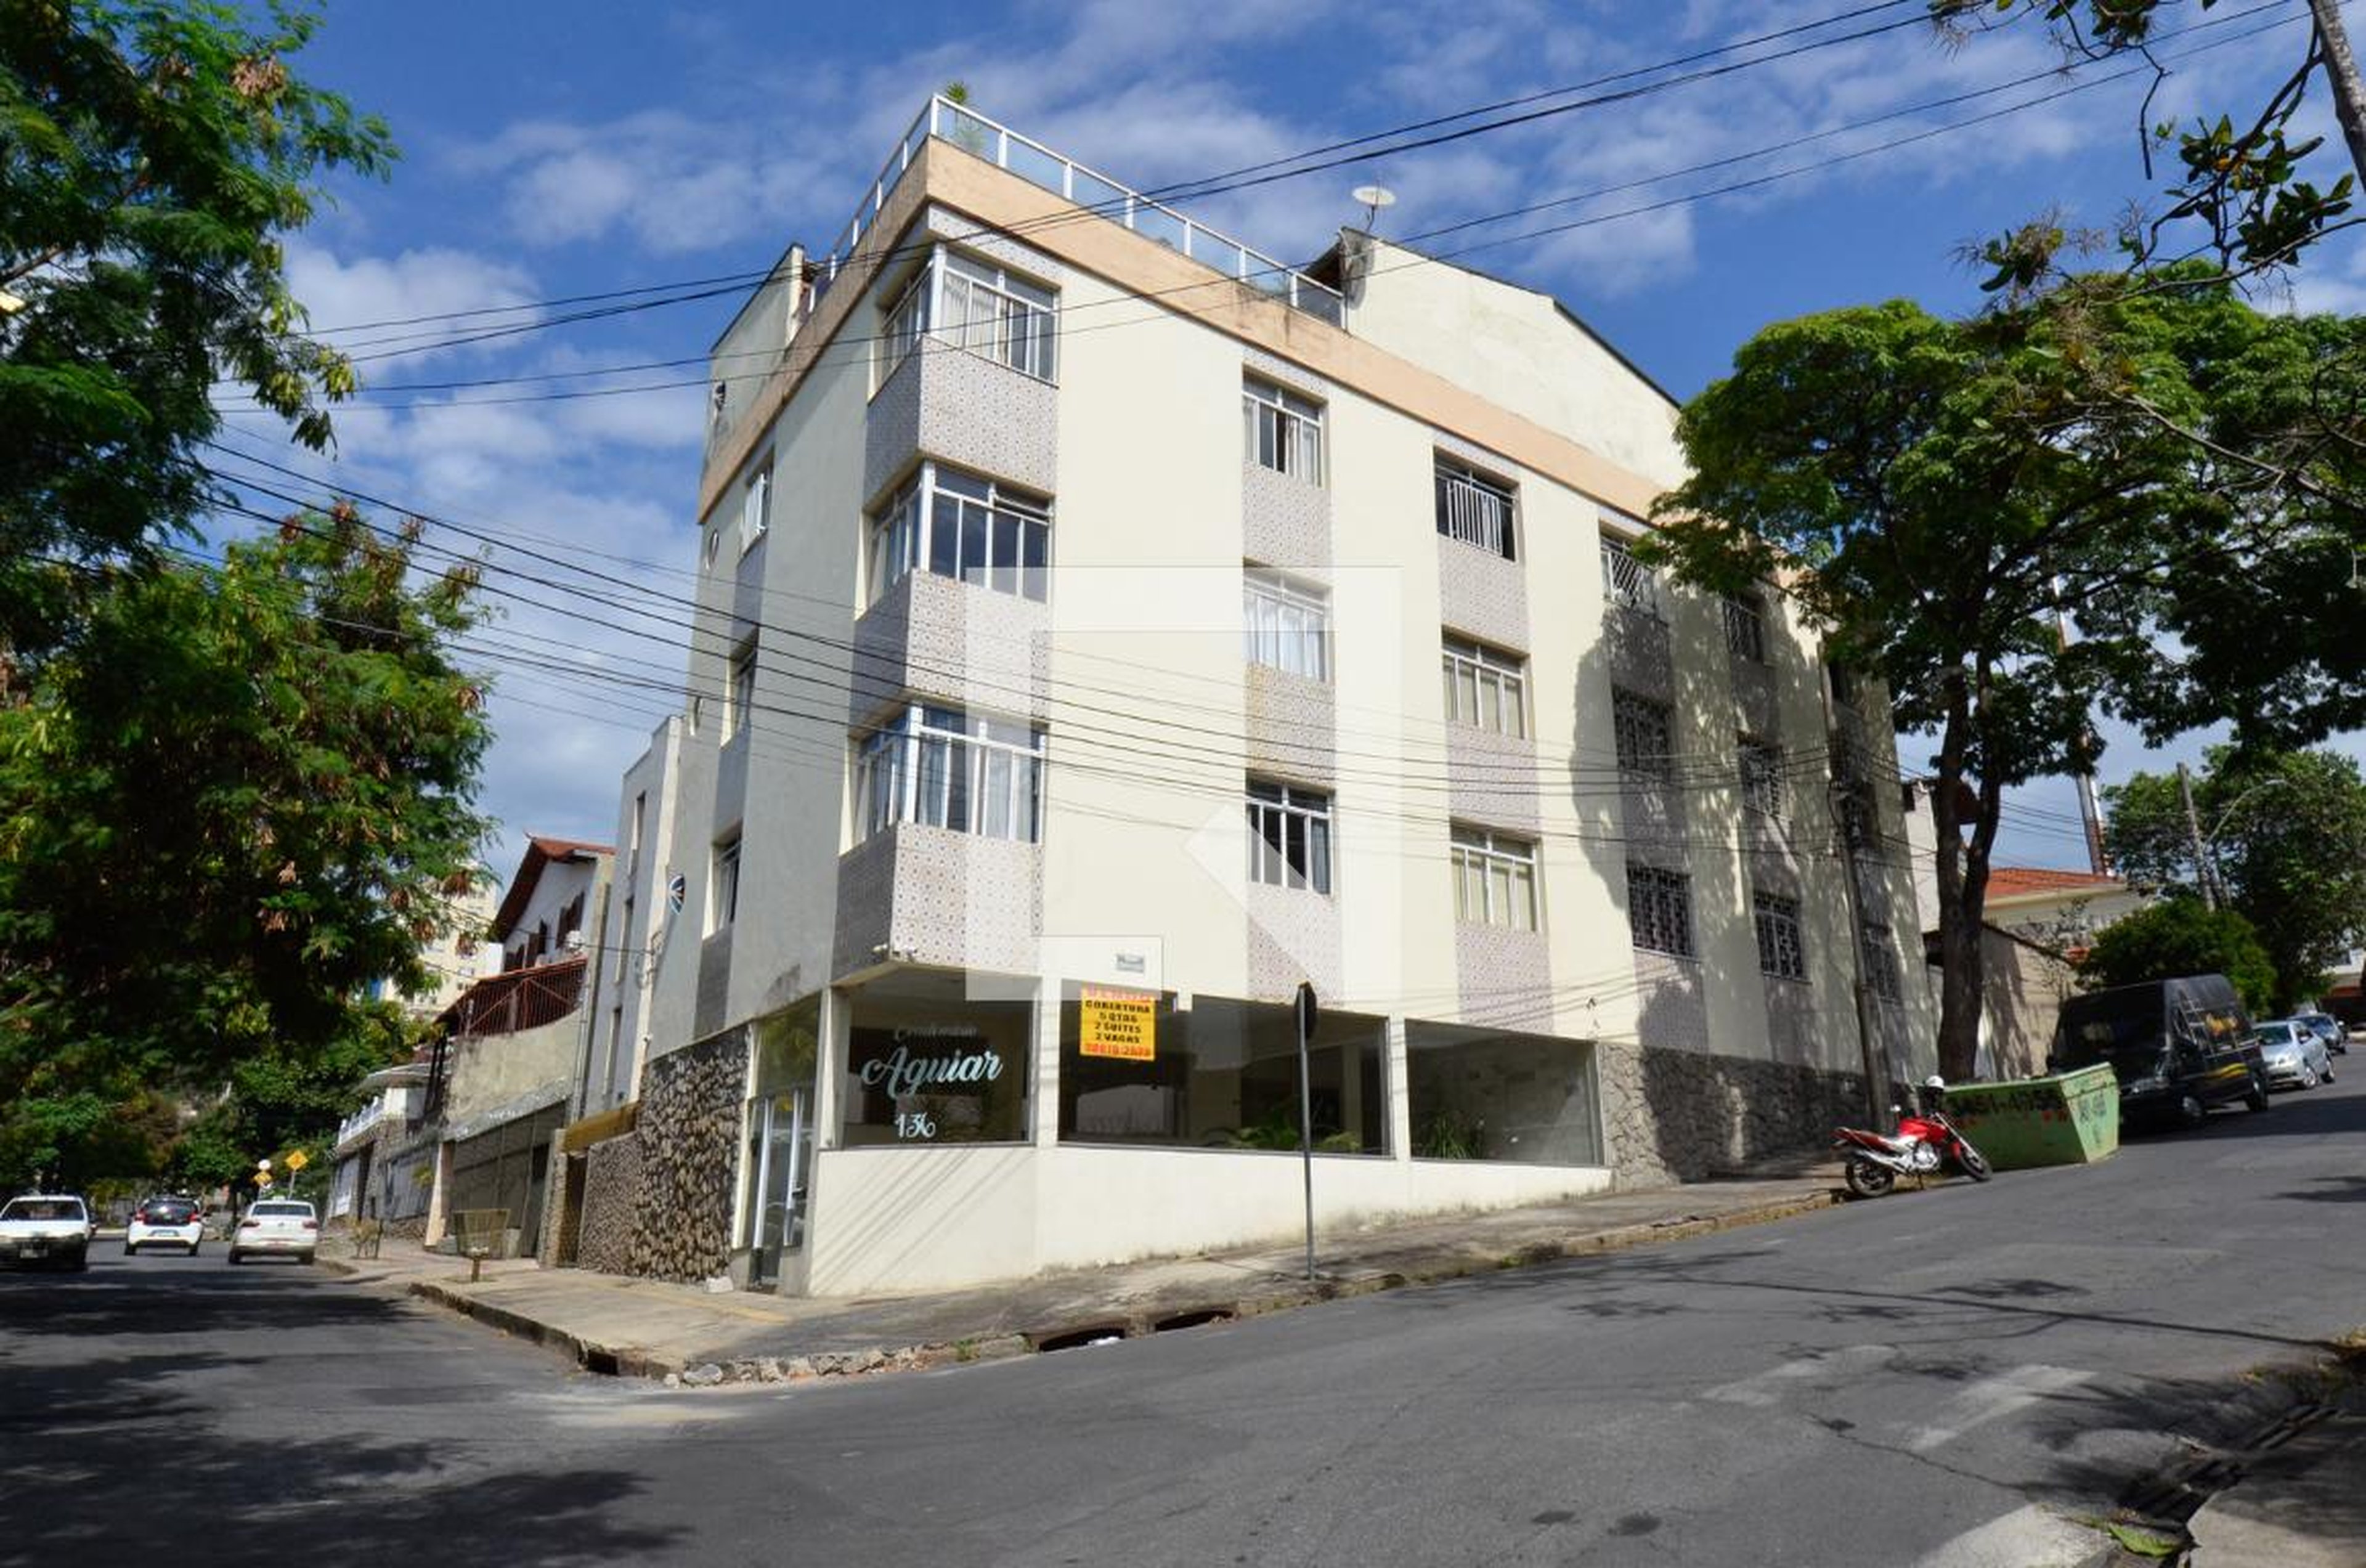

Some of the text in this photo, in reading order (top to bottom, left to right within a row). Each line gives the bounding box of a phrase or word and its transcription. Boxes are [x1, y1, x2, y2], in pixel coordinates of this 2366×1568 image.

[1085, 1000, 1150, 1013] COBERTURA
[1104, 1033, 1140, 1044] VAGAS
[861, 1046, 1004, 1100] Aguiar
[895, 1111, 937, 1138] 136
